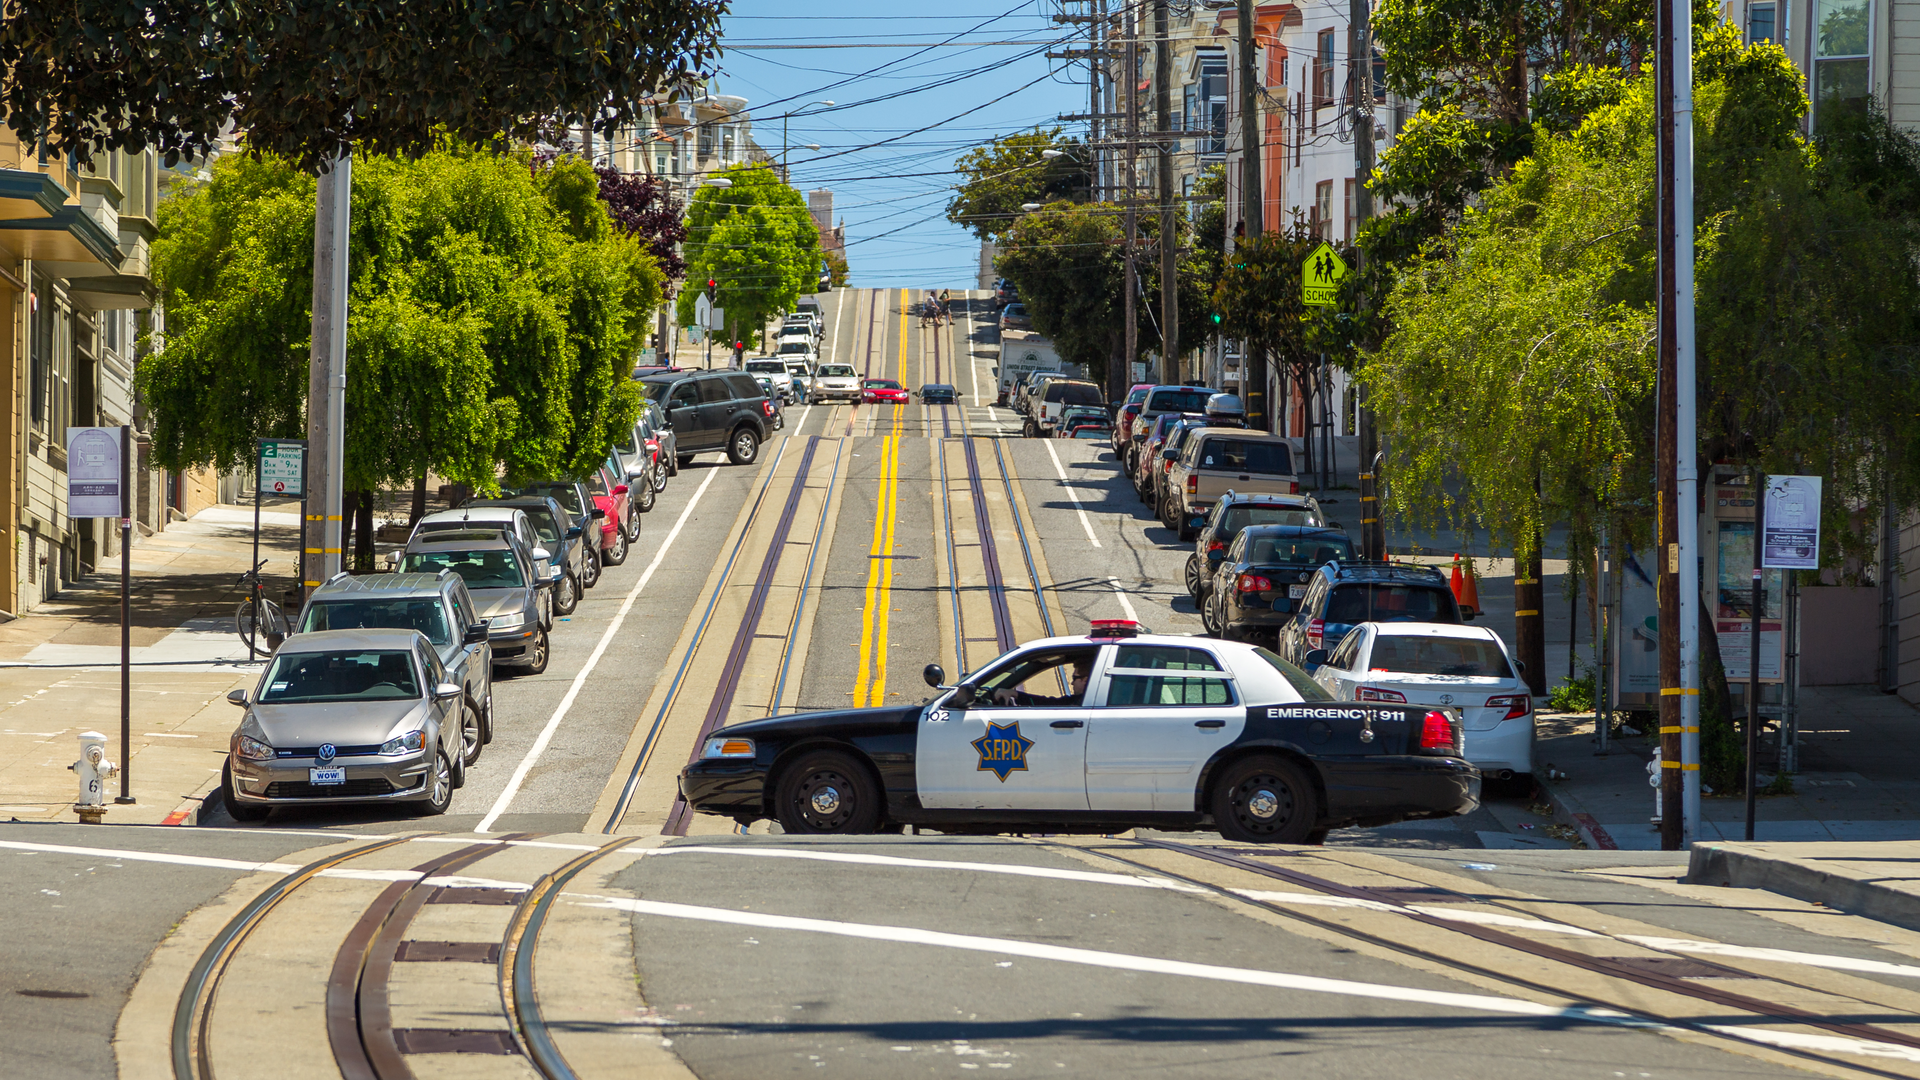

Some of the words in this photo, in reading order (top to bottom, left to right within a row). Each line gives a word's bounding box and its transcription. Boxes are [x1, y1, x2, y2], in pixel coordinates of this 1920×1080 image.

[264, 445, 274, 456] 2
[924, 712, 950, 722] 102
[1267, 708, 1372, 720] EMERGENCY
[1380, 710, 1405, 721] 911
[88, 780, 98, 792] 6
